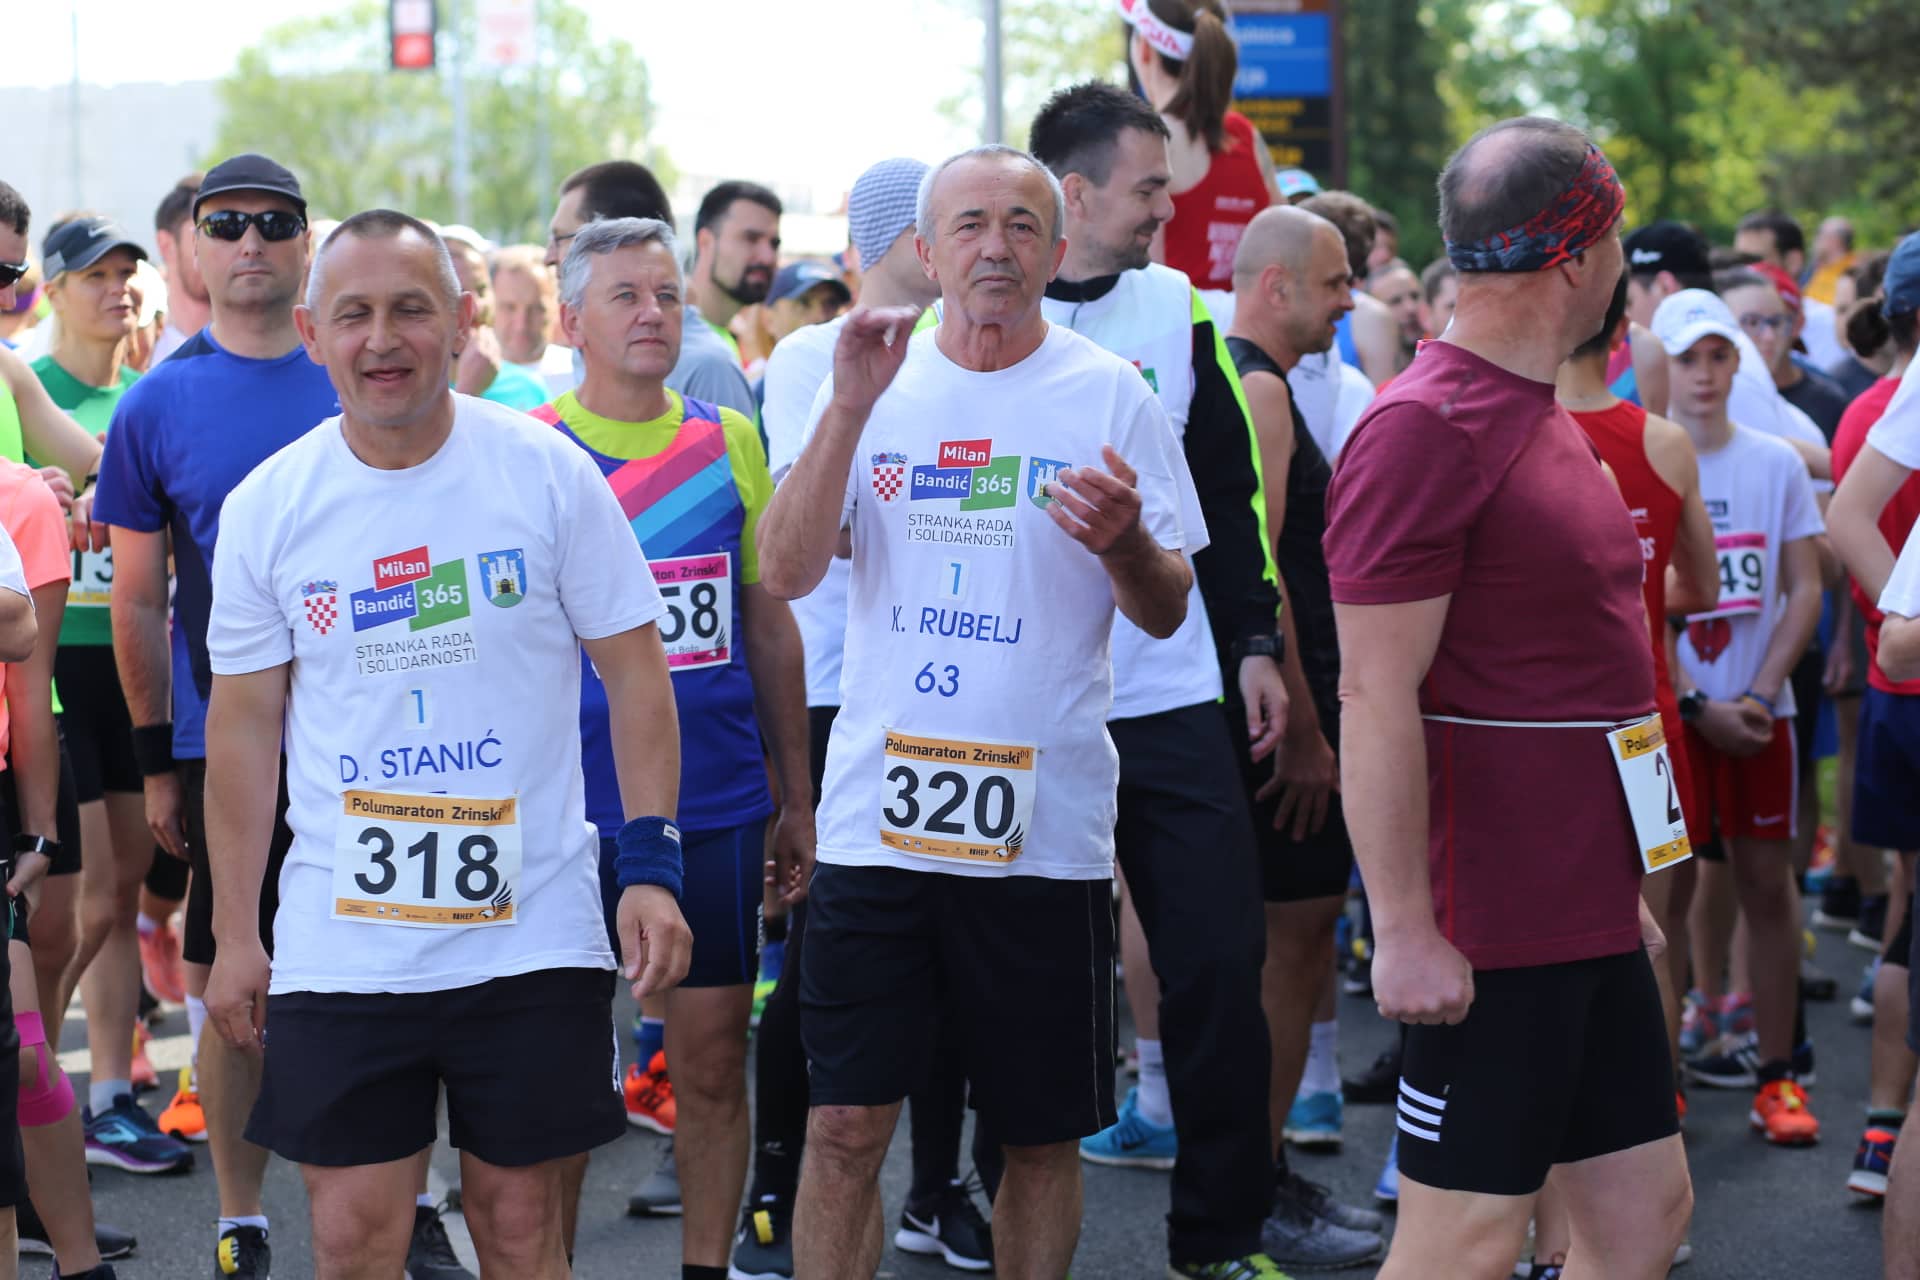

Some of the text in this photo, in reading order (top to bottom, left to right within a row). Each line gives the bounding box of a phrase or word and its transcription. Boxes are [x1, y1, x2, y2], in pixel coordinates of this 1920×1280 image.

[943, 445, 986, 462] Milan
[914, 472, 969, 490] Bandić
[975, 474, 1012, 495] 365
[908, 513, 1013, 532] STRANKA RADA
[915, 529, 1013, 547] SOLIDARNOSTI
[377, 561, 427, 579] Milan
[950, 562, 962, 595] 1
[354, 594, 414, 615] Bandić
[421, 583, 463, 609] 365
[919, 606, 1022, 644] RUBELJ
[355, 632, 474, 659] STRANKA RADA
[357, 647, 477, 675] I SOLIDARNOSTI
[914, 661, 960, 698] 63
[411, 689, 425, 724] 1
[340, 729, 503, 783] D. STANIĆ
[885, 737, 966, 760] Polumaraton
[973, 748, 1020, 765] Zrinski
[352, 797, 444, 819] Polumaraton
[452, 806, 502, 821] Zrinski
[883, 765, 1015, 839] 320
[354, 826, 500, 901] 318
